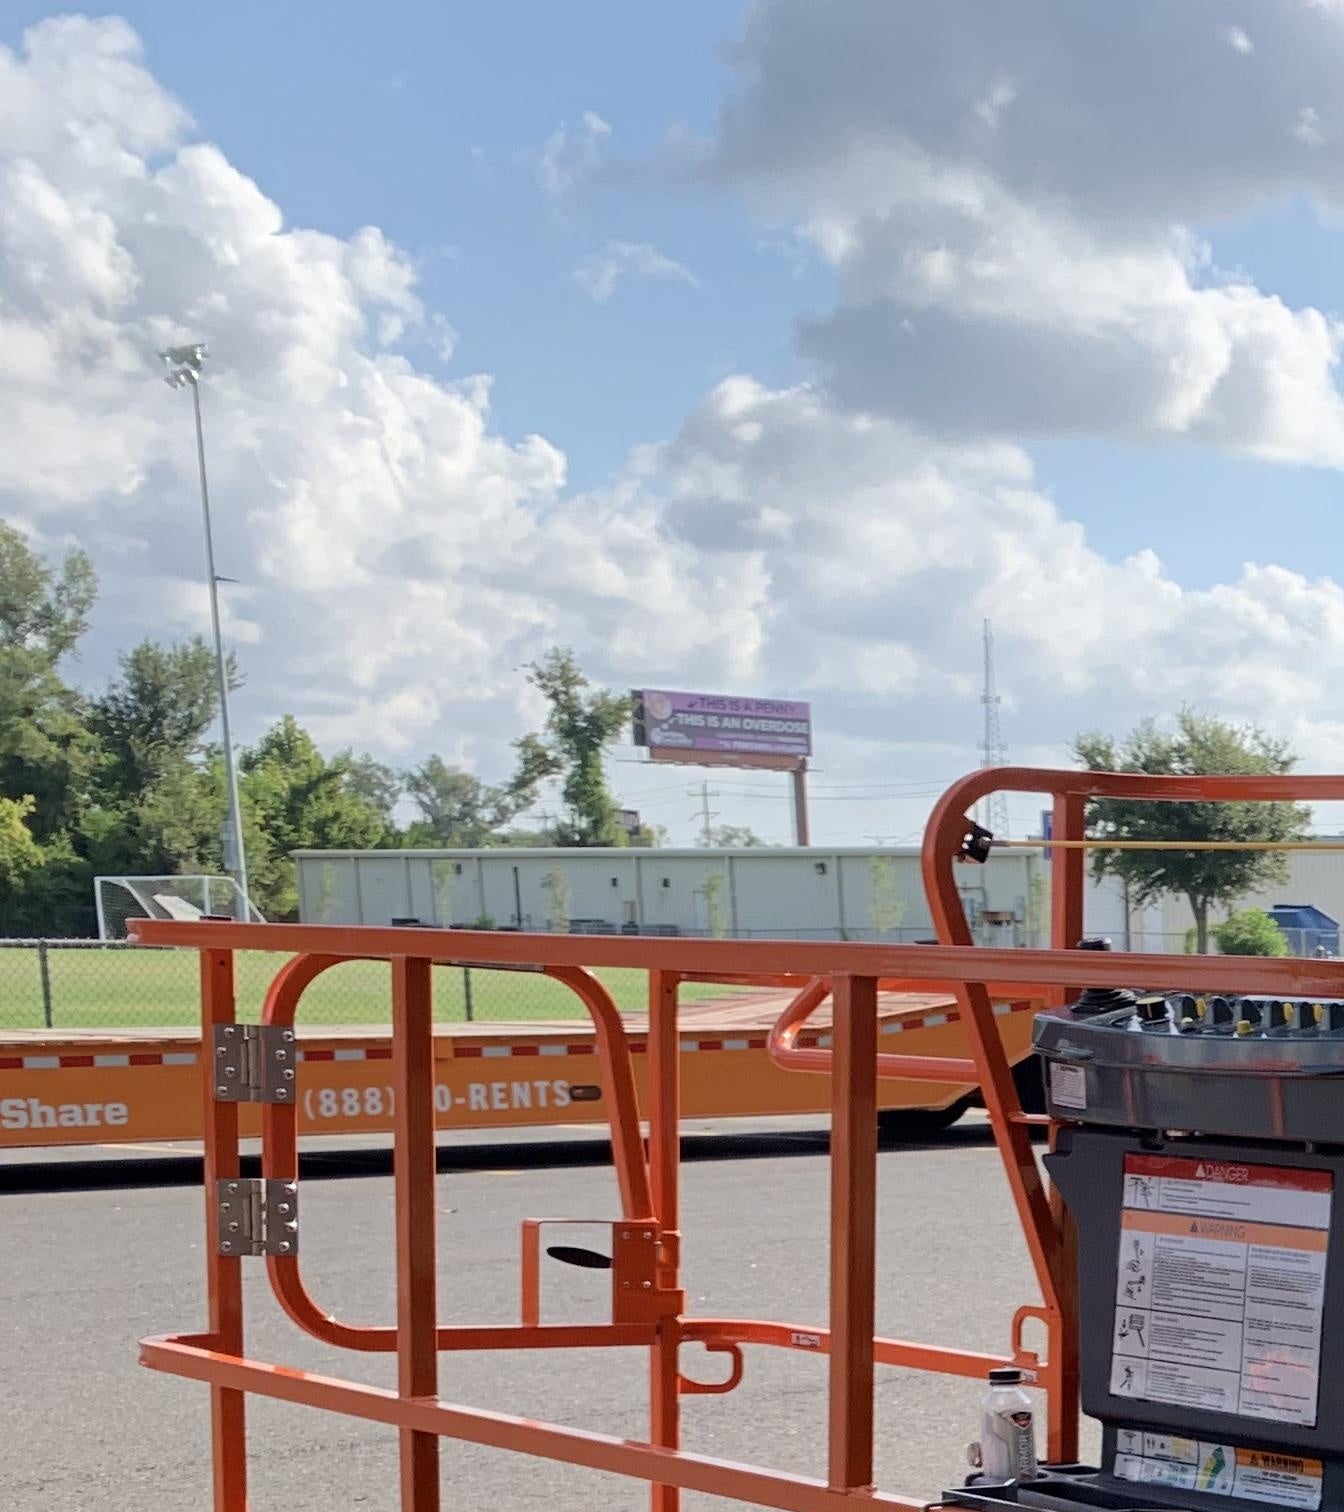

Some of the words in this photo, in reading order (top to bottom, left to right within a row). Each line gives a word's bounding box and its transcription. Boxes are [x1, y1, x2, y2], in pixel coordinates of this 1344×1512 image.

[699, 698, 727, 710] THIS
[730, 700, 739, 711] IS
[743, 701, 752, 712] A
[756, 703, 795, 714] PENNY
[677, 713, 705, 727] THIS
[707, 715, 720, 728] IS
[722, 717, 741, 730] AN
[743, 719, 809, 734] OVERDOSE
[303, 1087, 397, 1120] (888)
[434, 1079, 571, 1113] 0-RENTS
[0, 1098, 129, 1129] Share
[1205, 1164, 1249, 1183] DANGER
[1200, 1221, 1246, 1240] WARNING
